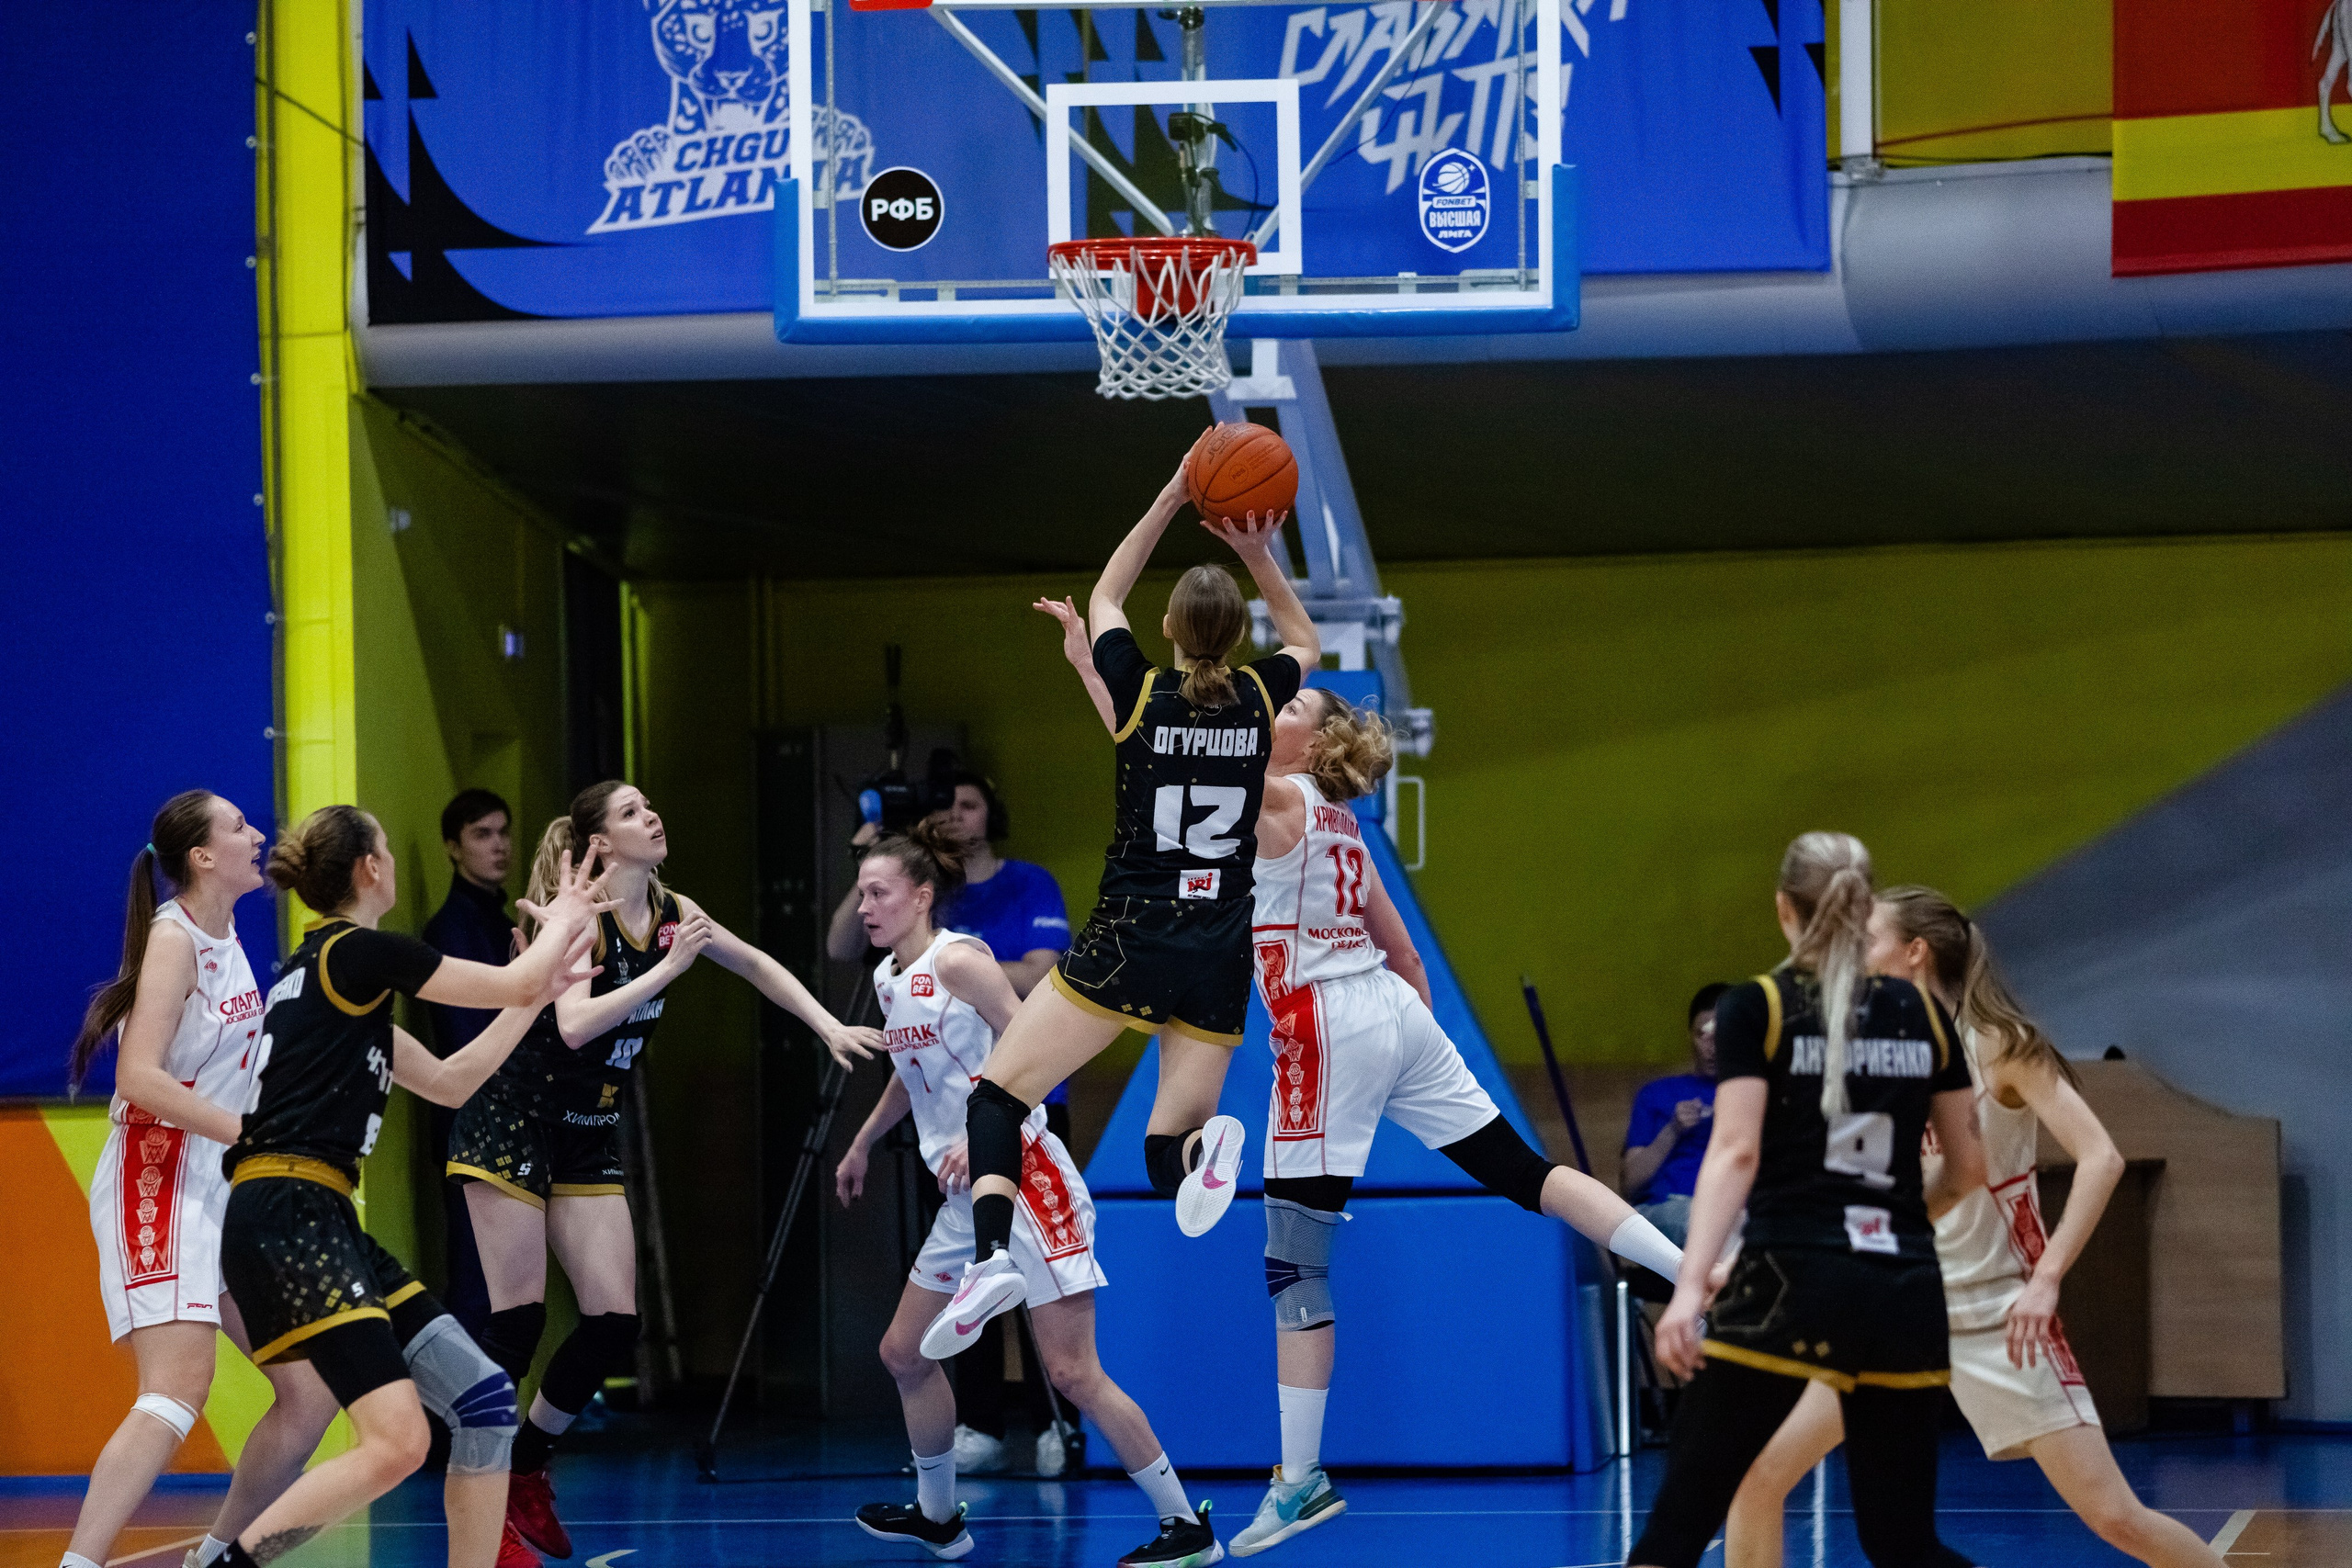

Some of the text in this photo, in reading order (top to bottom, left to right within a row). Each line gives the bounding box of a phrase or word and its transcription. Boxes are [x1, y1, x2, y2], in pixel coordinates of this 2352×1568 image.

[673, 129, 790, 173] CHGU
[871, 197, 933, 221] РФБ
[1436, 197, 1473, 206] FONBET
[1430, 210, 1481, 228] ВЫСШАЯ
[1438, 230, 1473, 238] ЛИГА
[1154, 726, 1258, 757] ОГУРЦОВА
[1153, 785, 1247, 859] 12
[1325, 844, 1365, 917] 12
[659, 935, 673, 946] BE
[912, 976, 932, 985] FON
[912, 985, 933, 995] BET
[240, 1029, 257, 1070] 7
[605, 1036, 644, 1070] 10
